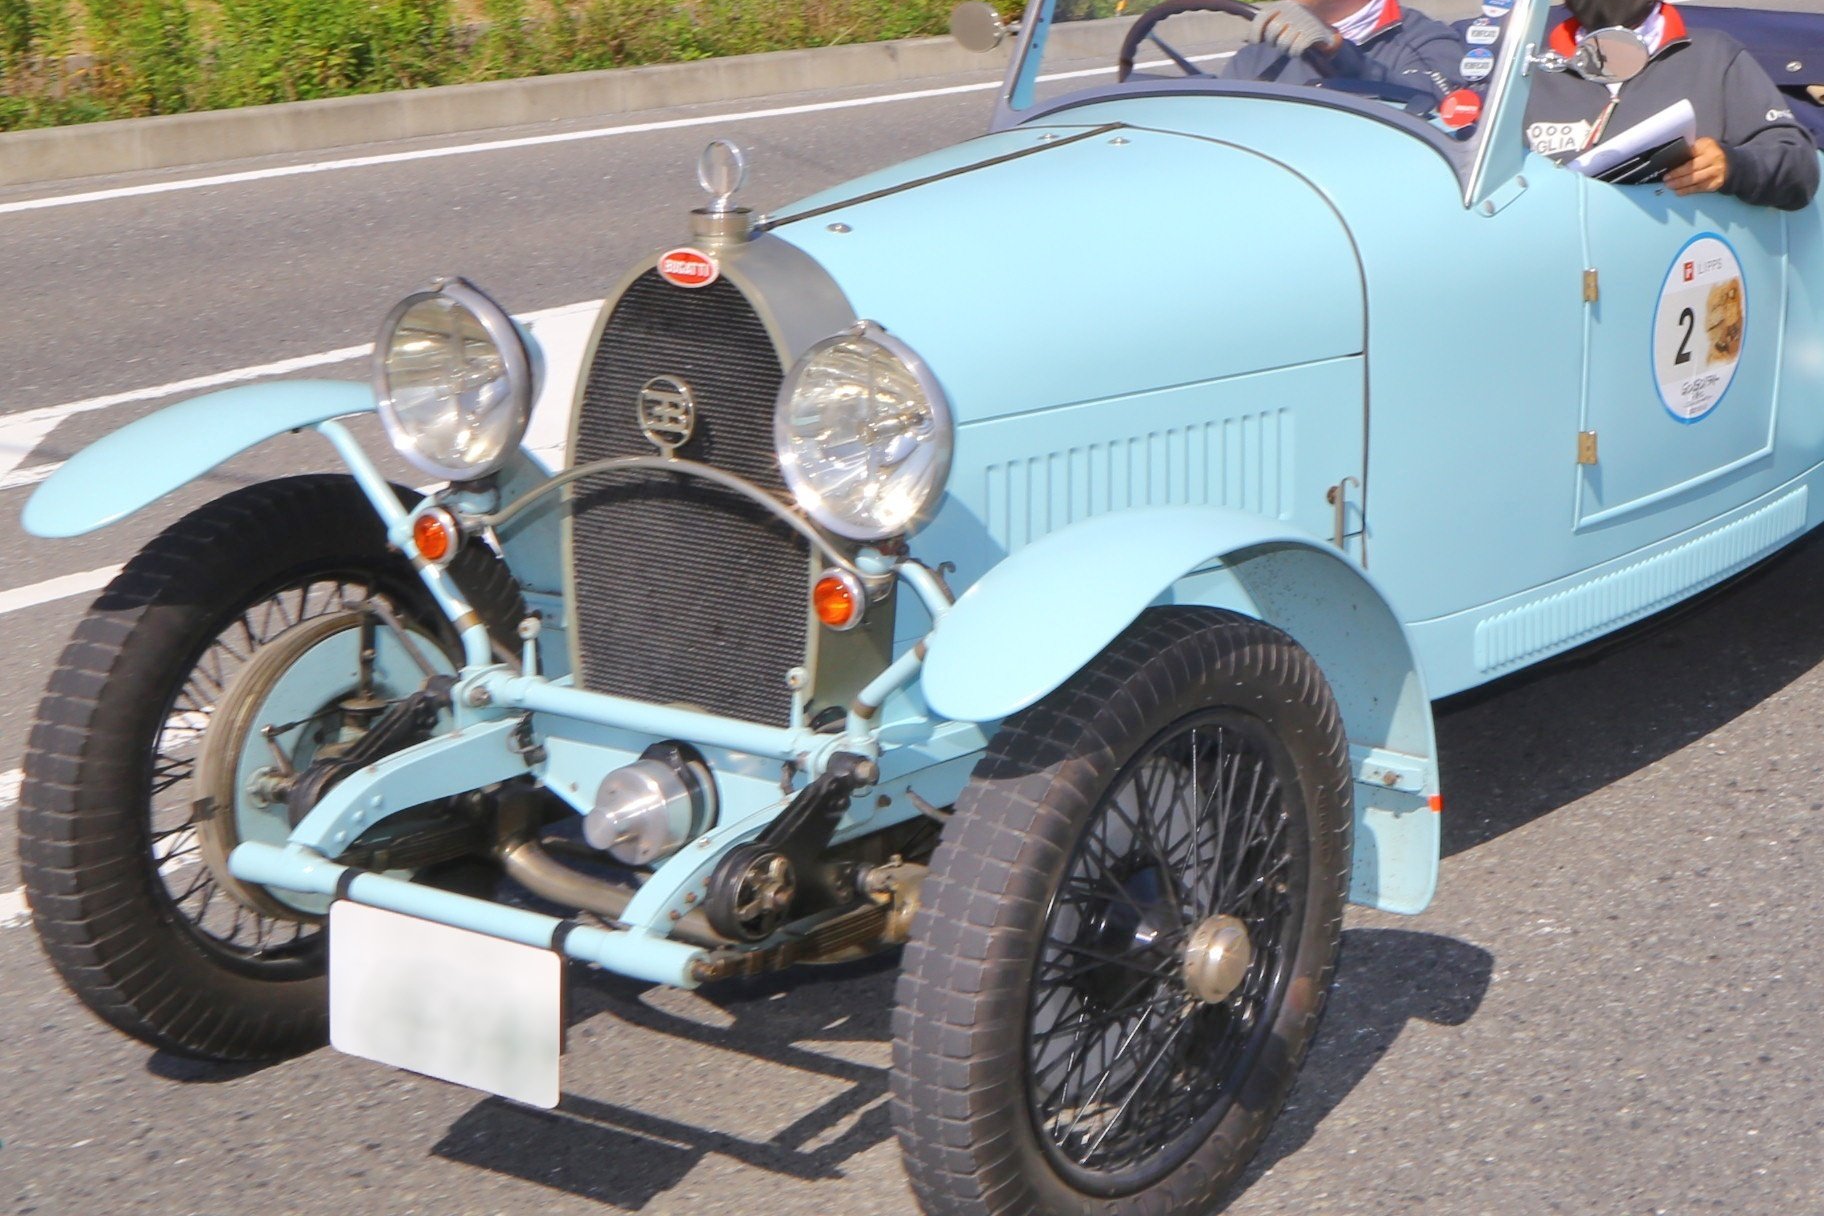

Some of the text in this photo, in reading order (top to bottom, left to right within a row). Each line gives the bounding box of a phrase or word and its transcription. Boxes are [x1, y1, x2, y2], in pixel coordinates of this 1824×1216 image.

[1531, 125, 1572, 139] 000
[1536, 137, 1576, 154] GLIA
[662, 258, 710, 277] BUGATTI
[1674, 307, 1694, 365] 2
